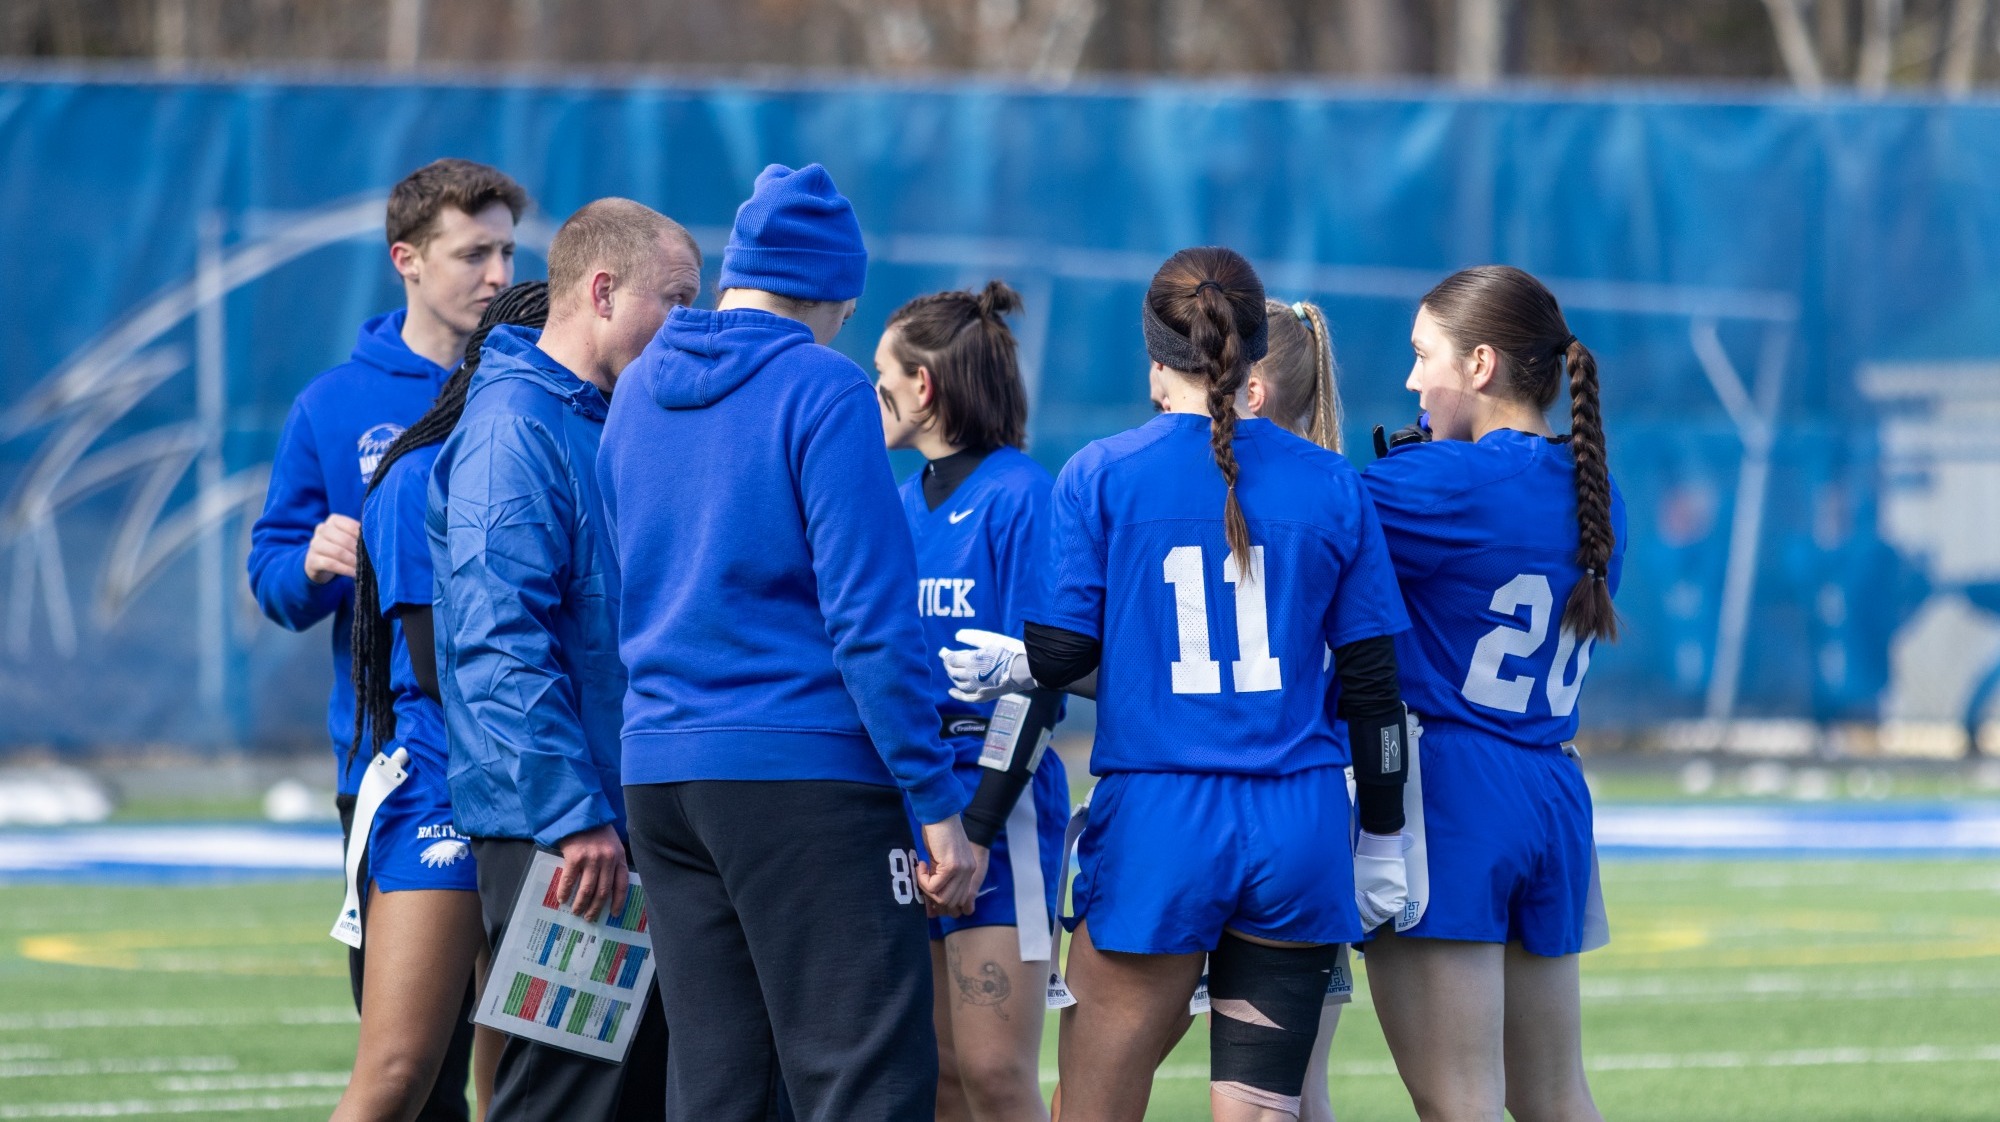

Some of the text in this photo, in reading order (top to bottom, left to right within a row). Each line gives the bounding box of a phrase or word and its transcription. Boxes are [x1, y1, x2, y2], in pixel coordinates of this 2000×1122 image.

[1163, 545, 1282, 694] 11
[1461, 573, 1596, 717] 20
[1404, 900, 1420, 922] H
[1328, 985, 1351, 993] ARTWICK
